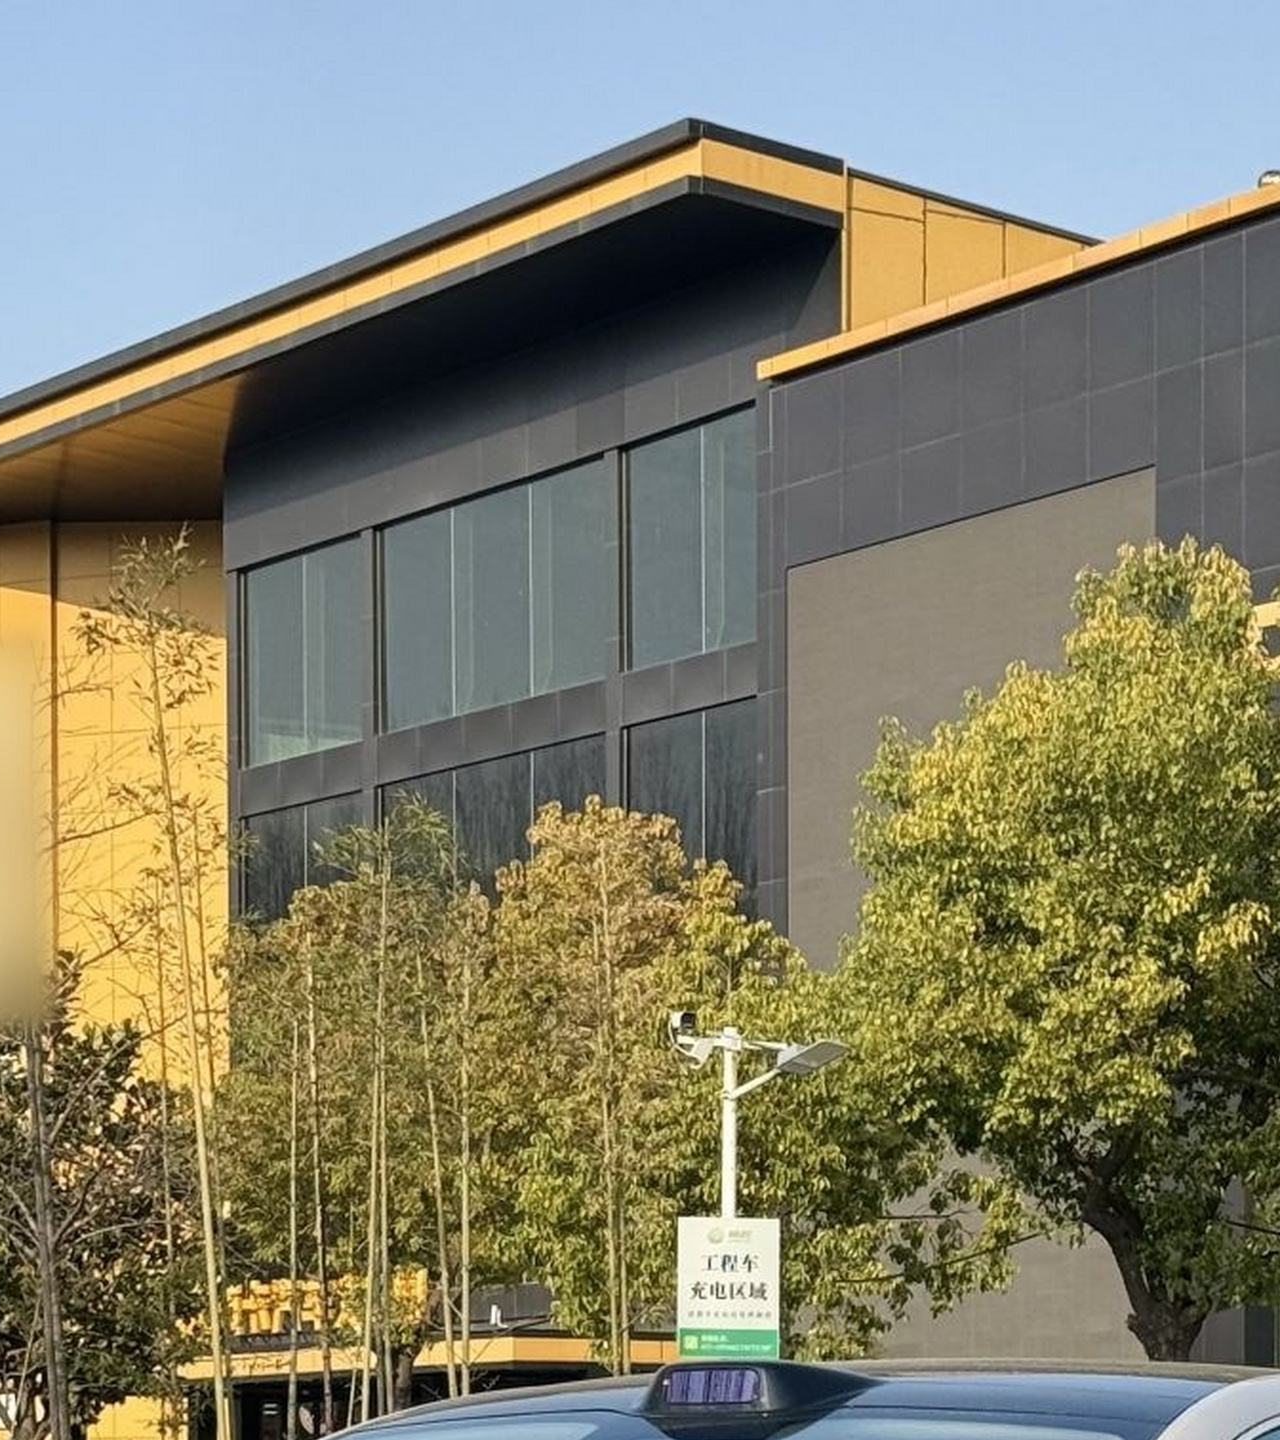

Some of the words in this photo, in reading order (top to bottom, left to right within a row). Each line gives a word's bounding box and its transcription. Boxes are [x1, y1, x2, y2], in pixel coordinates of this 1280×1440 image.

[701, 1253, 760, 1273] 工程车
[689, 1280, 769, 1301] 充电区域
